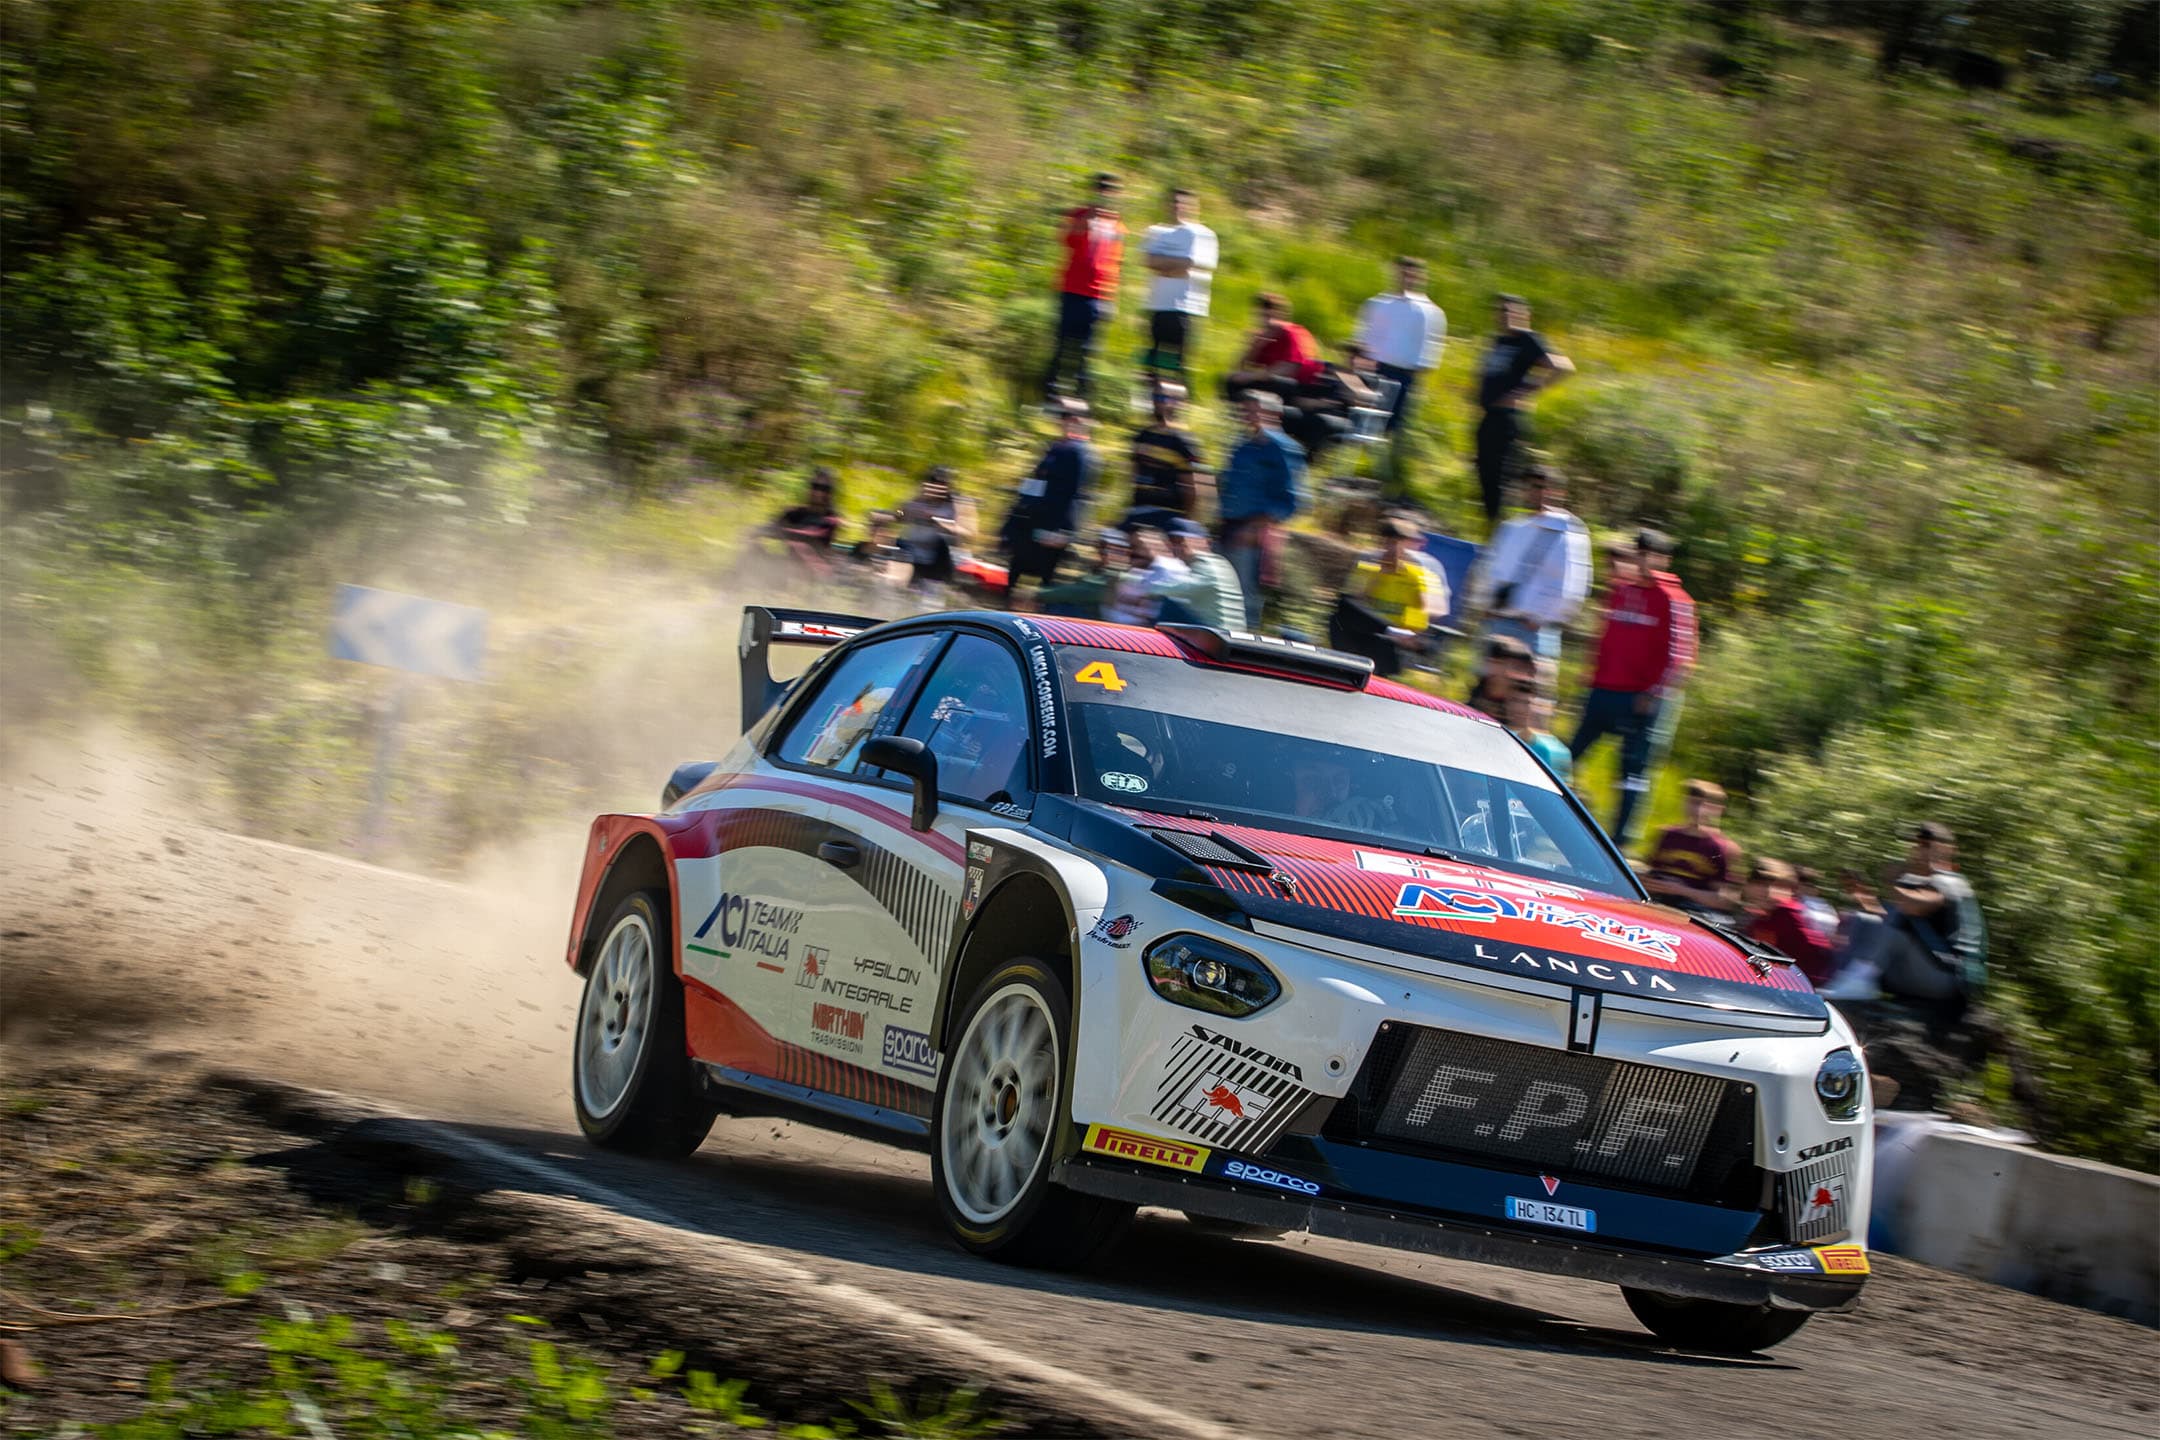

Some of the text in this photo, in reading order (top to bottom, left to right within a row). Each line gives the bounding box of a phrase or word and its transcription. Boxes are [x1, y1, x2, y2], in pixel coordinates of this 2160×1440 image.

[1074, 660, 1128, 692] 4
[1102, 772, 1146, 792] FIA
[693, 892, 750, 947] ACI
[751, 901, 795, 929] TEAM
[741, 928, 790, 961] ITALIA
[854, 956, 921, 986] YPSILON
[1474, 944, 1677, 992] LANCIA
[821, 977, 913, 1014] INTEGRALE
[1093, 1127, 1200, 1168] PIRELLI
[1225, 1160, 1321, 1195] sparco
[1516, 1200, 1586, 1228] HC 134 TL
[1820, 1249, 1866, 1271] PIRELLI
